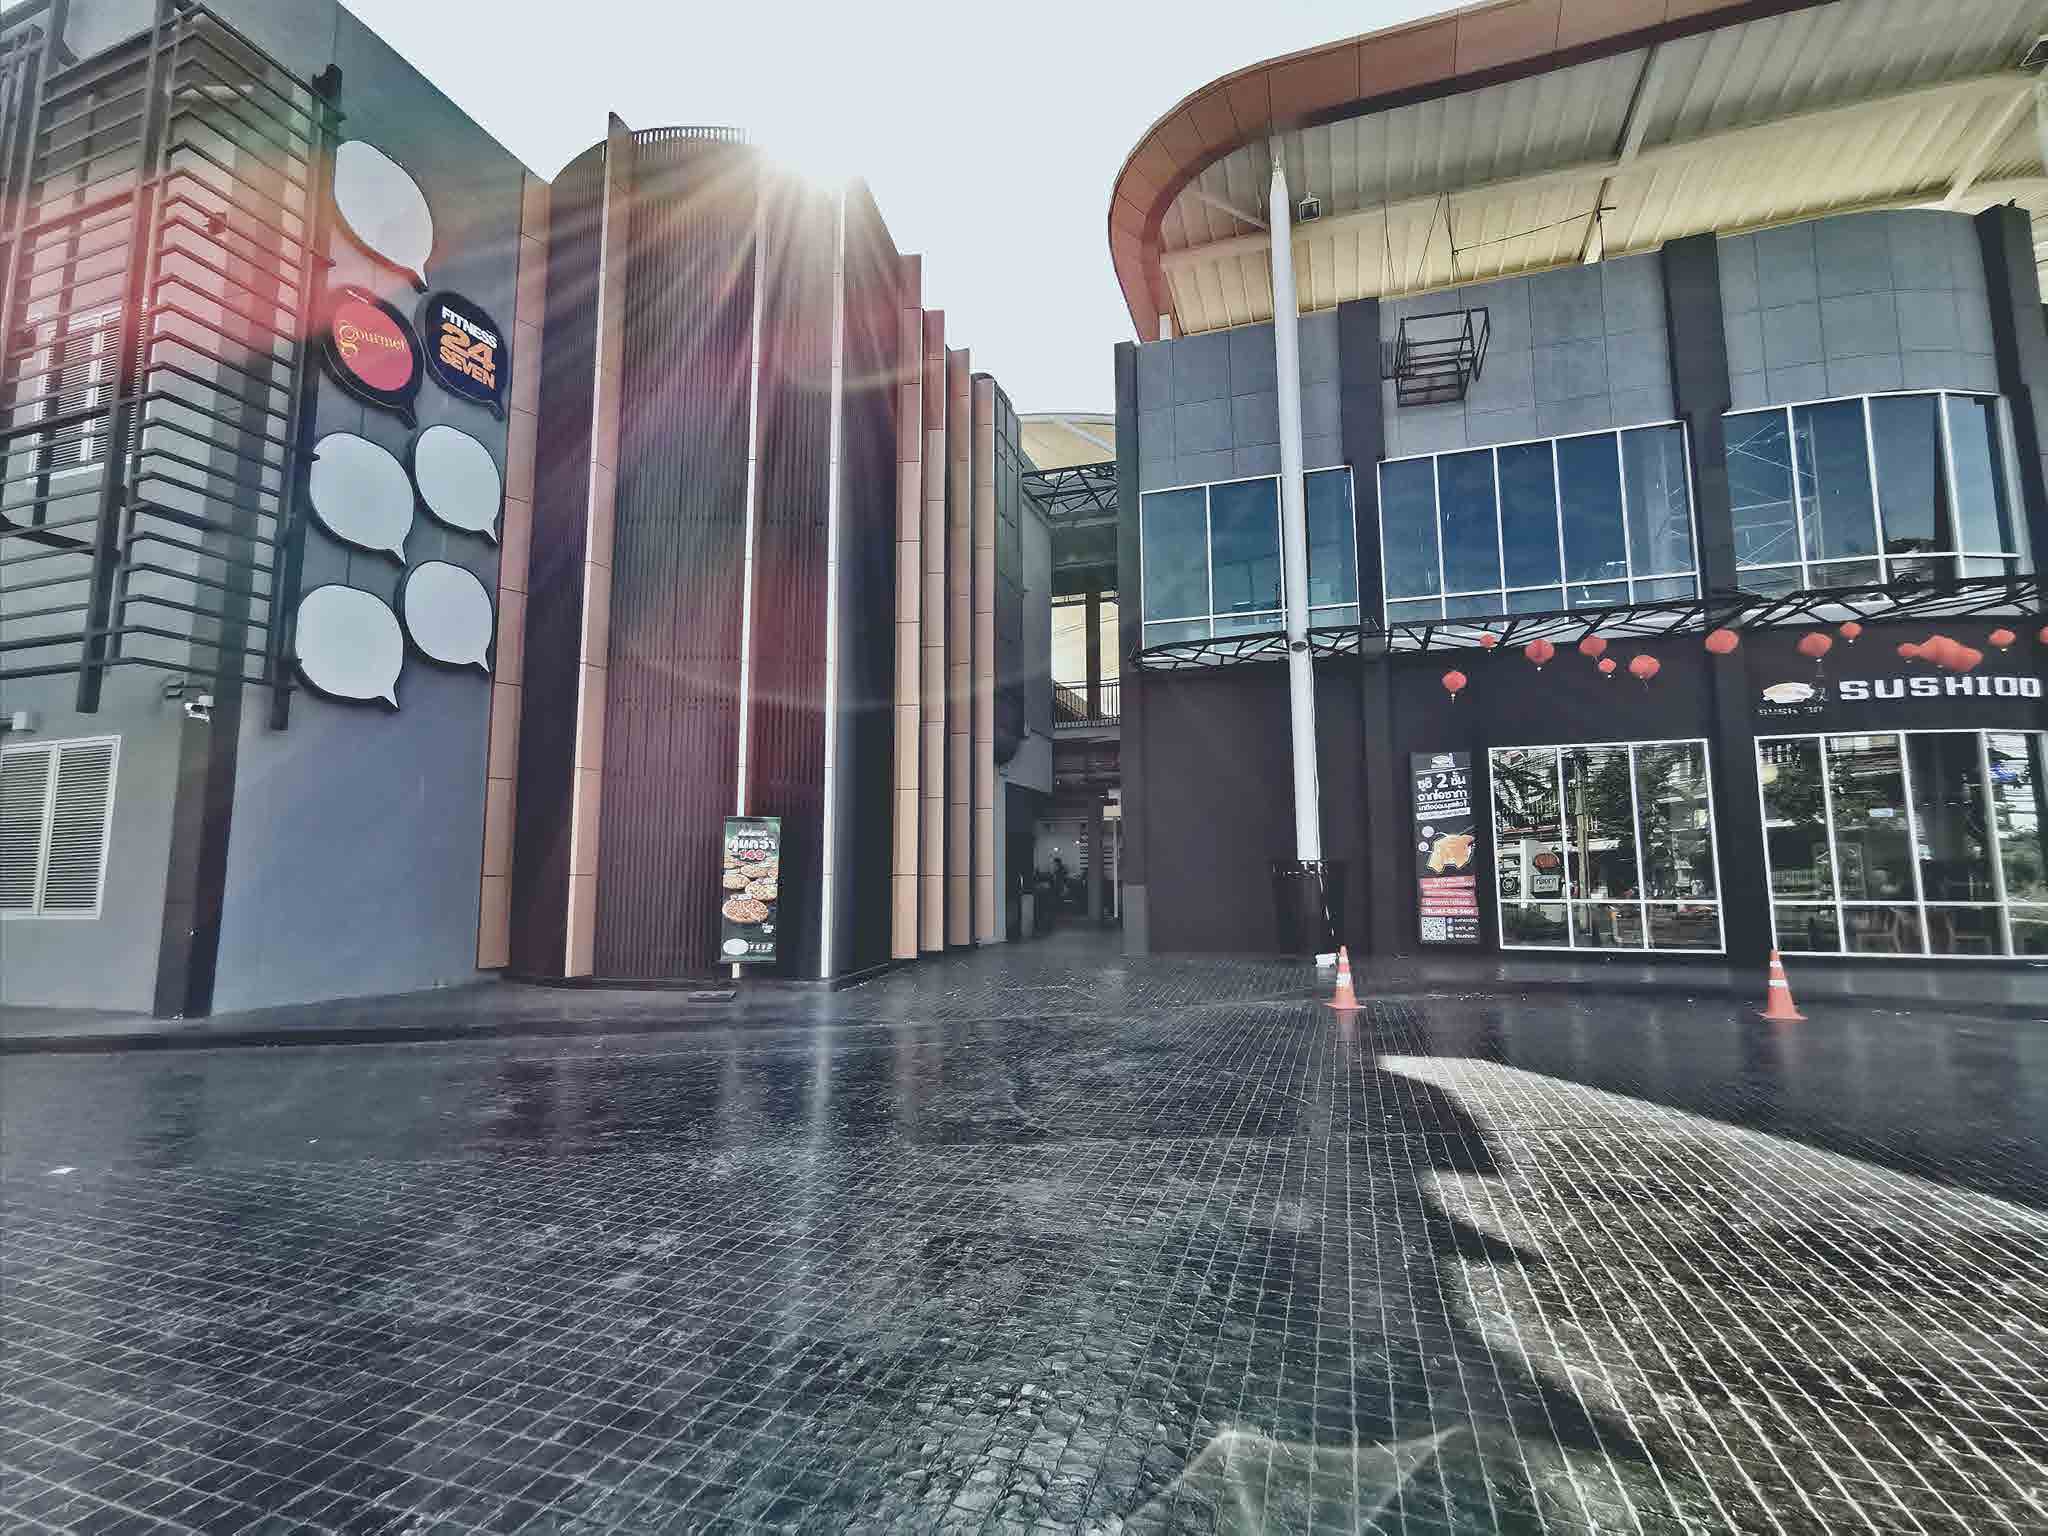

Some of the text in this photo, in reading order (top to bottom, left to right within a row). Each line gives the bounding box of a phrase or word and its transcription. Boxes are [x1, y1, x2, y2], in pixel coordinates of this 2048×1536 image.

[440, 322, 496, 372] 24
[441, 305, 498, 350] FITNESS
[439, 346, 496, 391] SEVEN
[1436, 773, 1449, 789] 2
